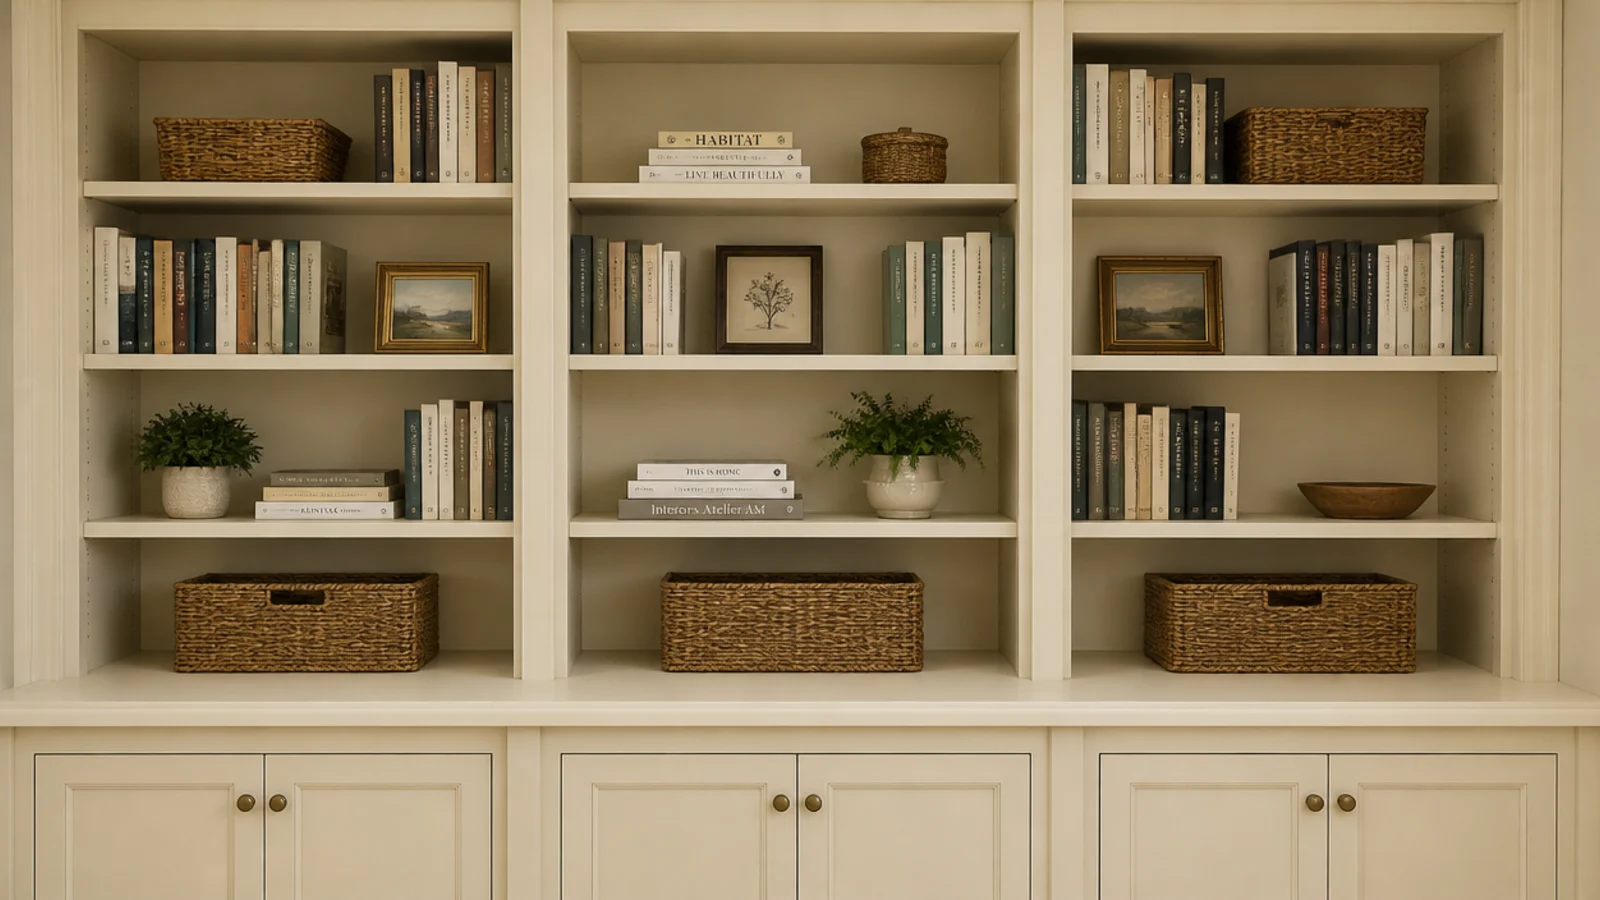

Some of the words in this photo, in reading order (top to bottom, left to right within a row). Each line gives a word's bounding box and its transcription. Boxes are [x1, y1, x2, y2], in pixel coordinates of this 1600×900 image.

[695, 134, 762, 146] HABITAT
[702, 503, 742, 515] Atelier
[745, 503, 765, 515] AM
